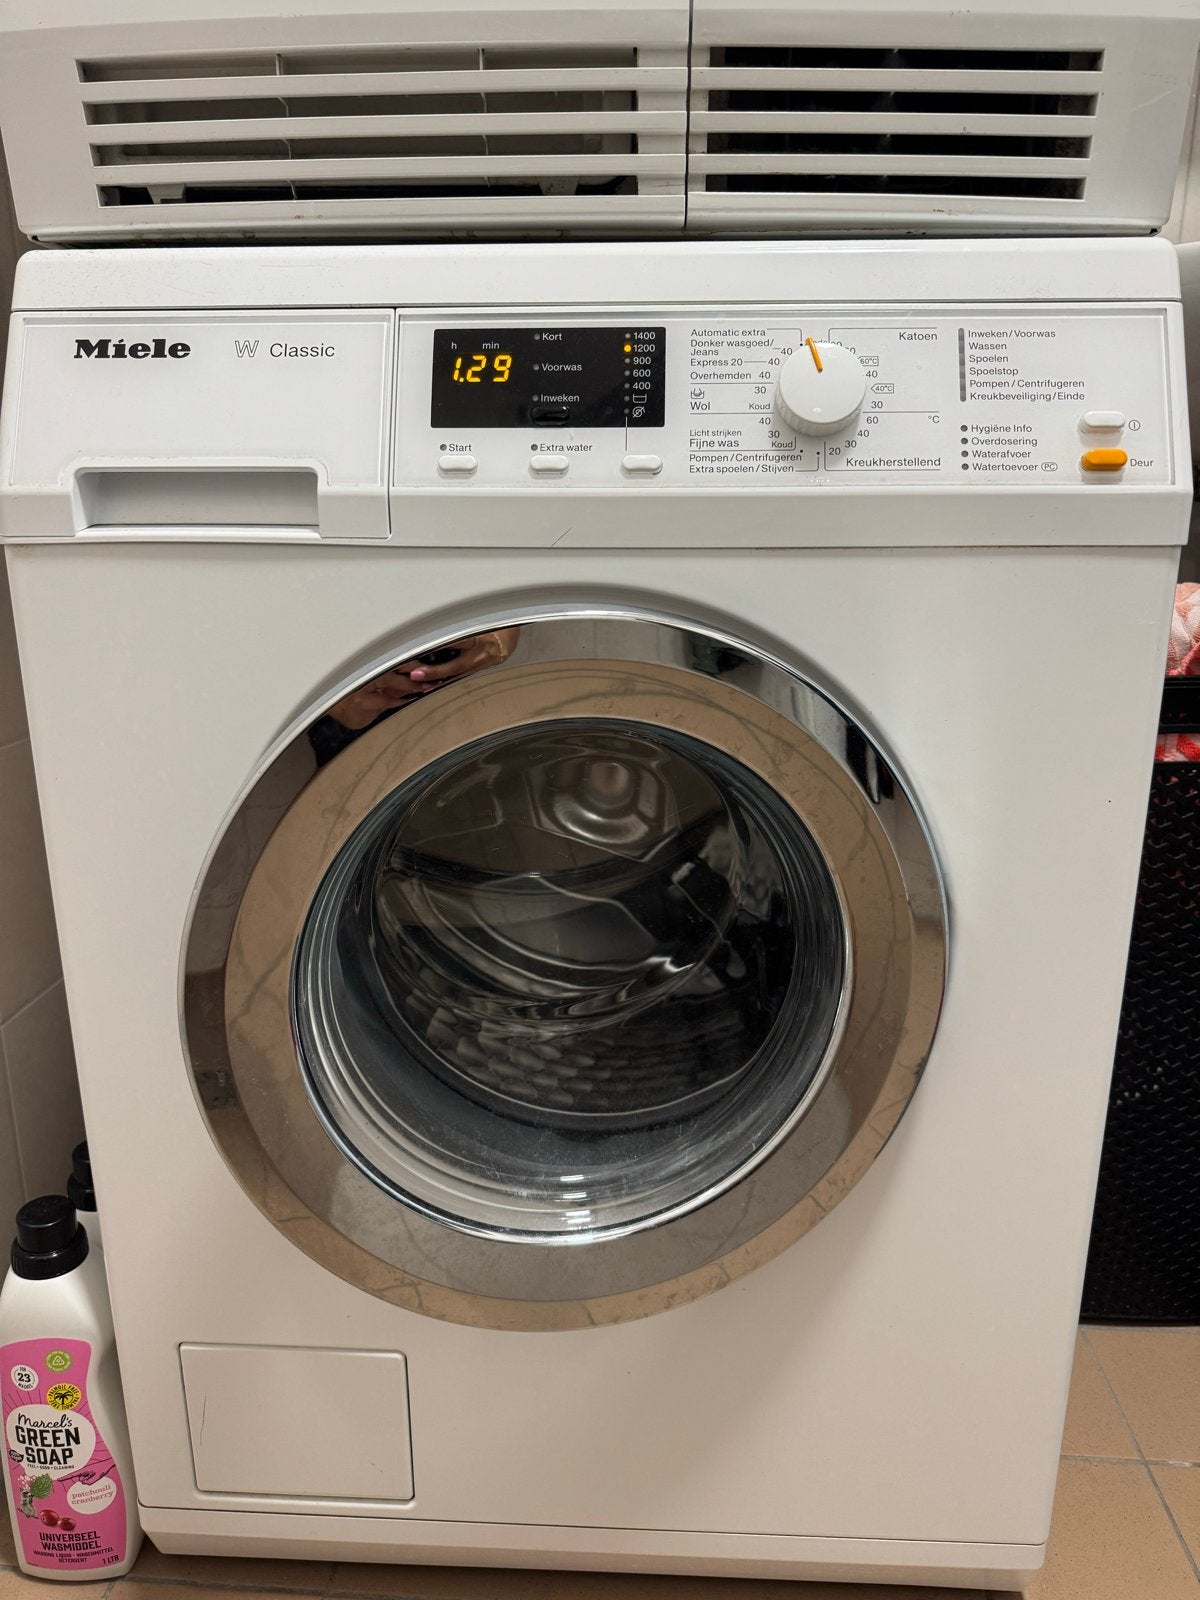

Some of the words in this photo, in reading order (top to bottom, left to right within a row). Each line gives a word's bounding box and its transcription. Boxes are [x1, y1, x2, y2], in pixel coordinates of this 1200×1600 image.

[542, 332, 562, 341] Kort
[633, 332, 656, 340] 1400
[899, 332, 938, 340] Katoen
[451, 342, 458, 350] h
[482, 342, 500, 350] min
[632, 344, 656, 352] 1200
[690, 339, 724, 347] Donker
[726, 339, 774, 349] wasgoed/
[968, 342, 1007, 350] Wassen
[74, 338, 191, 360] Miele
[235, 340, 259, 358] W
[269, 342, 335, 358] Classic
[690, 348, 719, 356] Jeans
[780, 348, 792, 356] 40
[633, 356, 652, 365] 900
[690, 358, 728, 368] Express
[731, 358, 742, 366] 20
[768, 358, 780, 366] 40
[968, 354, 1008, 364] Spoelen
[453, 354, 512, 383] 1.29
[541, 363, 582, 372] Voorwas
[969, 366, 1018, 376] Spoelstop
[633, 369, 651, 378] 600
[690, 371, 752, 380] Overhemden
[758, 371, 771, 379] 40
[866, 370, 878, 378] 40
[632, 382, 651, 390] 400
[754, 386, 766, 394] 30
[540, 394, 580, 402] Inweken
[690, 402, 710, 410] Wol
[749, 402, 770, 410] Koud
[758, 417, 771, 425] 40
[866, 416, 878, 424] 60
[928, 415, 940, 424] °C
[971, 424, 1011, 434] Hygiëne
[1013, 424, 1032, 432] Info
[712, 430, 742, 438] strijken
[768, 430, 780, 438] 30
[857, 430, 870, 438] 40
[690, 438, 715, 449] Fijne
[718, 440, 740, 448] was
[844, 440, 857, 448] 30
[972, 437, 1038, 447] Overdosering
[448, 444, 472, 452] Start
[540, 444, 564, 452] Extra
[566, 444, 592, 452] water
[828, 448, 841, 456] 20
[972, 450, 1031, 458] Waterafvoer
[846, 458, 940, 467] Kreukherstellend
[972, 463, 1038, 471] Watertoevoer
[1130, 458, 1154, 468] Deur
[690, 465, 714, 474] Extra
[18, 1372, 31, 1382] 23
[18, 1413, 72, 1428] Marcel's
[15, 1425, 80, 1448] GREEN
[25, 1446, 74, 1465] SOAP
[72, 1484, 112, 1500] patchouli
[72, 1491, 114, 1504] cranberry
[40, 1531, 100, 1542] UNIVERSEEL
[42, 1540, 101, 1551] WASMIDDEL
[108, 1554, 120, 1564] LTR
